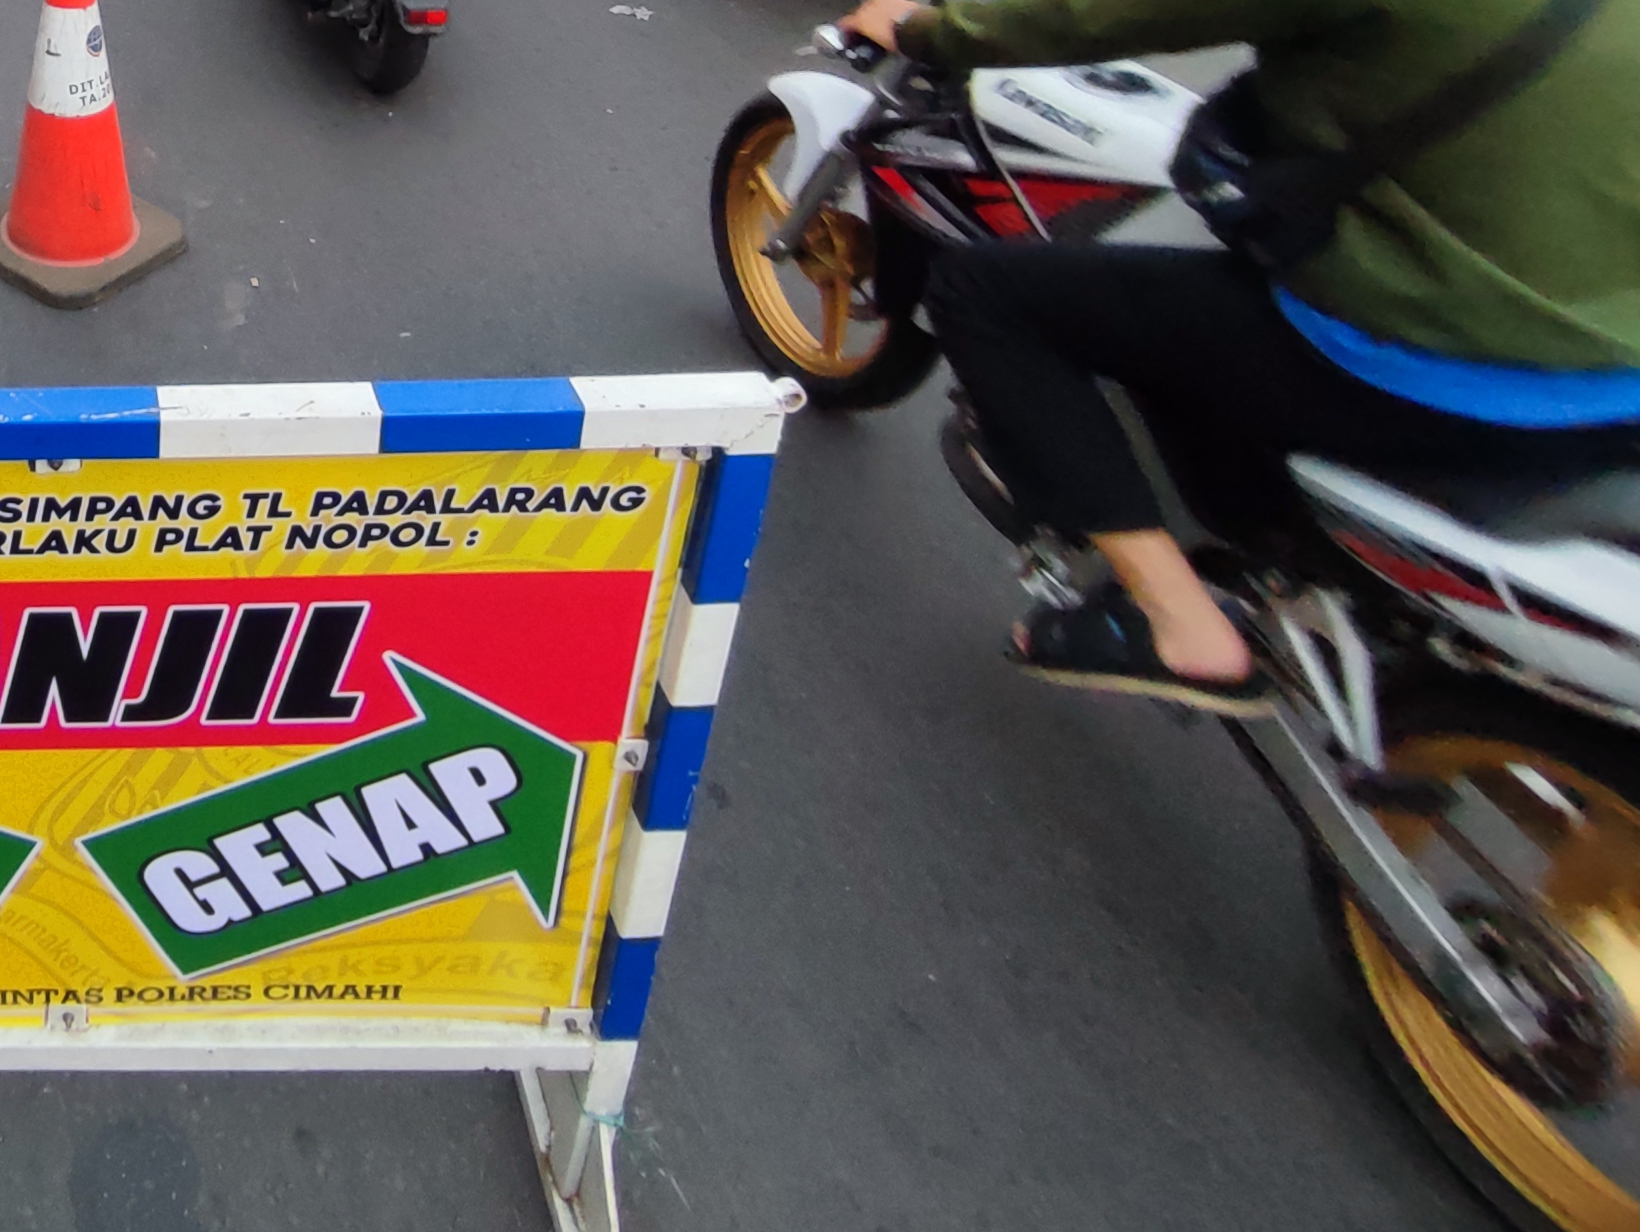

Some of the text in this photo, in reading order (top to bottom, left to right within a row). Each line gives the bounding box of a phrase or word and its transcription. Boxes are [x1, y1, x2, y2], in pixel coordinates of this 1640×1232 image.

[242, 492, 292, 519] TL
[310, 486, 647, 517] PADALARANG
[154, 525, 272, 553] PLAT
[285, 521, 450, 550] NOPOL
[140, 746, 523, 936] GENAP
[114, 985, 252, 1003] POLRES
[263, 984, 403, 1000] CIMAHI
